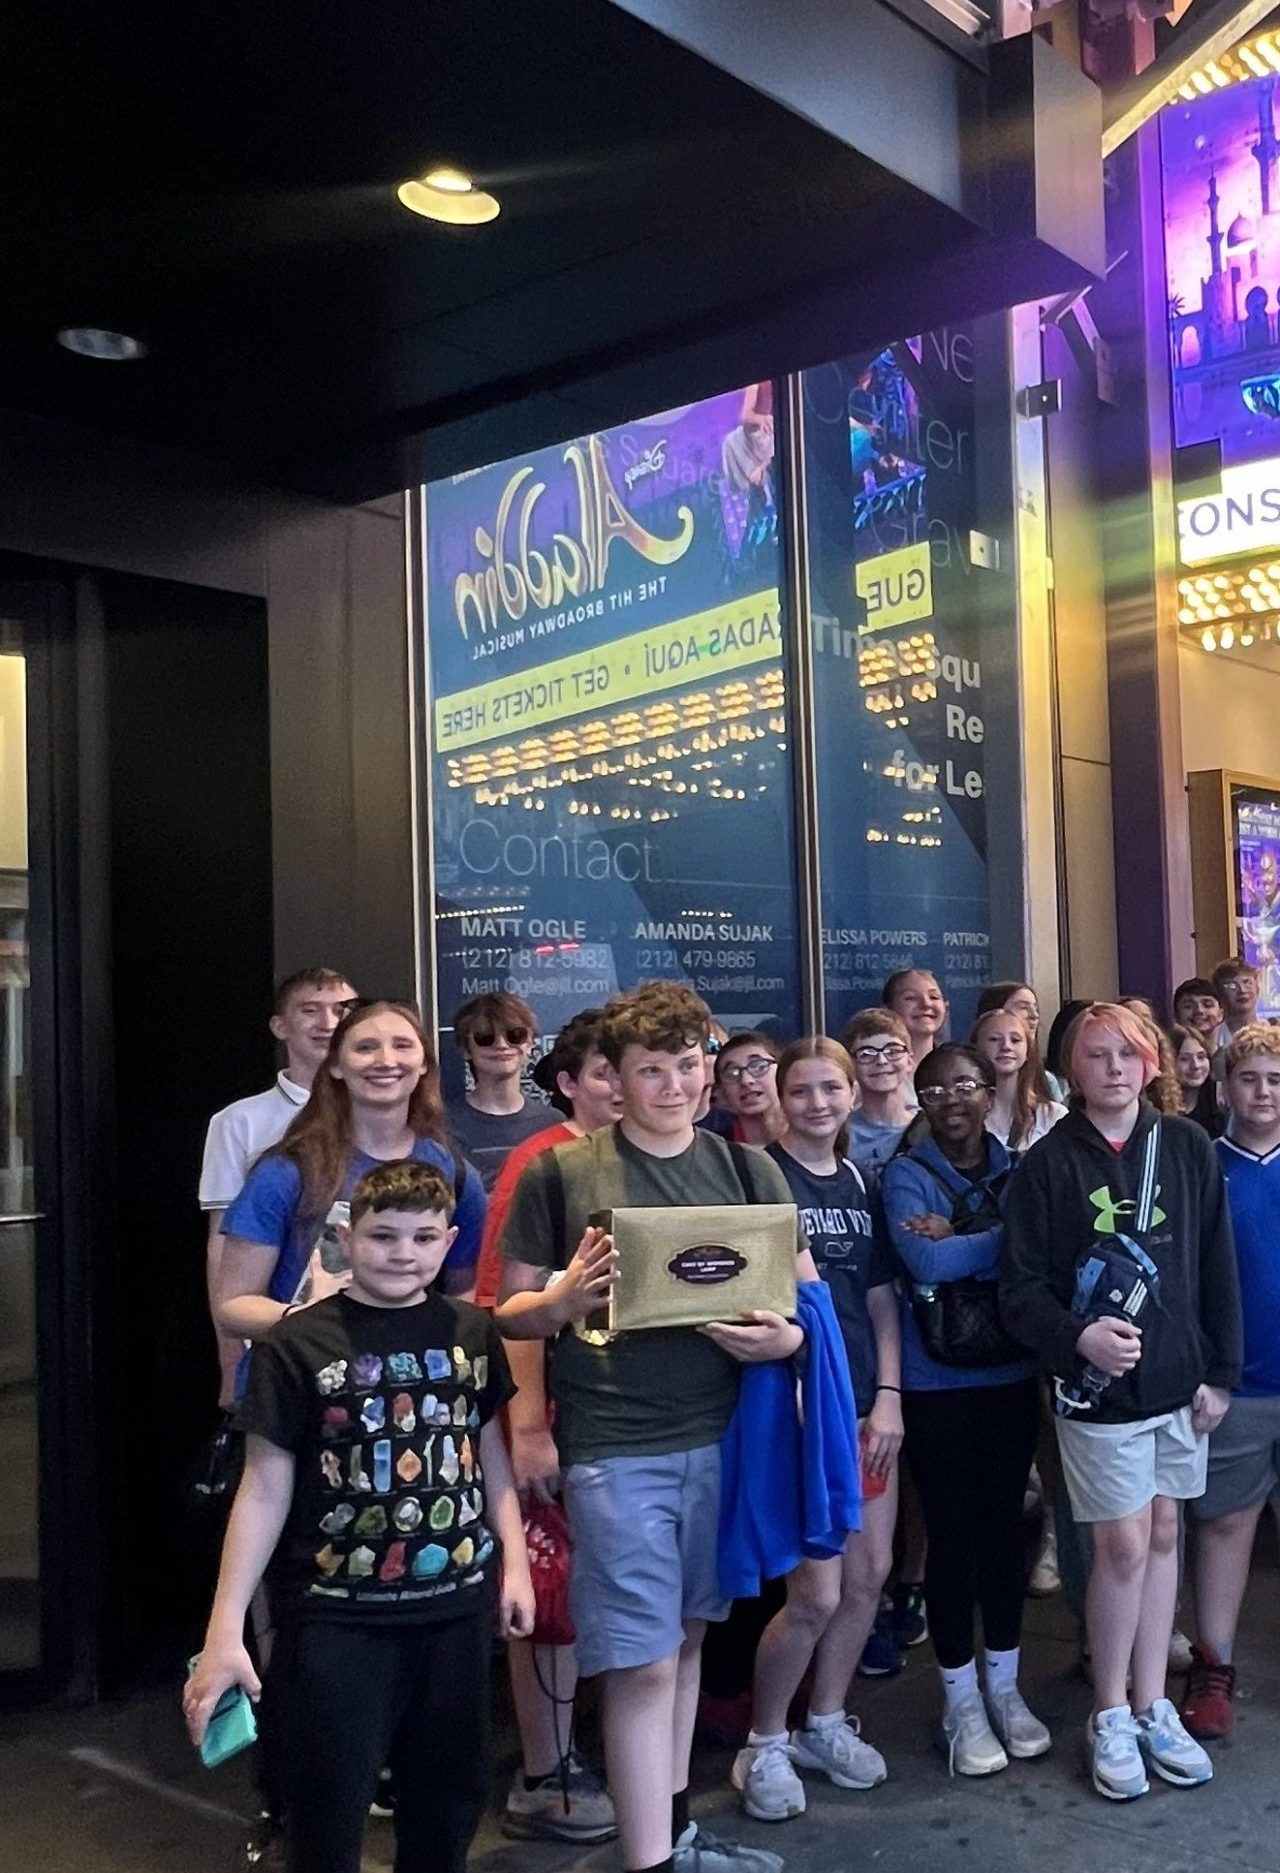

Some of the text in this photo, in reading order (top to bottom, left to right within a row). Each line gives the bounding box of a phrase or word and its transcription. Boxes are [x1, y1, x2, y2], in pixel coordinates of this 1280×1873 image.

[459, 819, 661, 883] Contact
[461, 917, 587, 940] MATT OGLE
[634, 922, 774, 942] AMANDA SUJAK
[871, 930, 928, 946] POWERS
